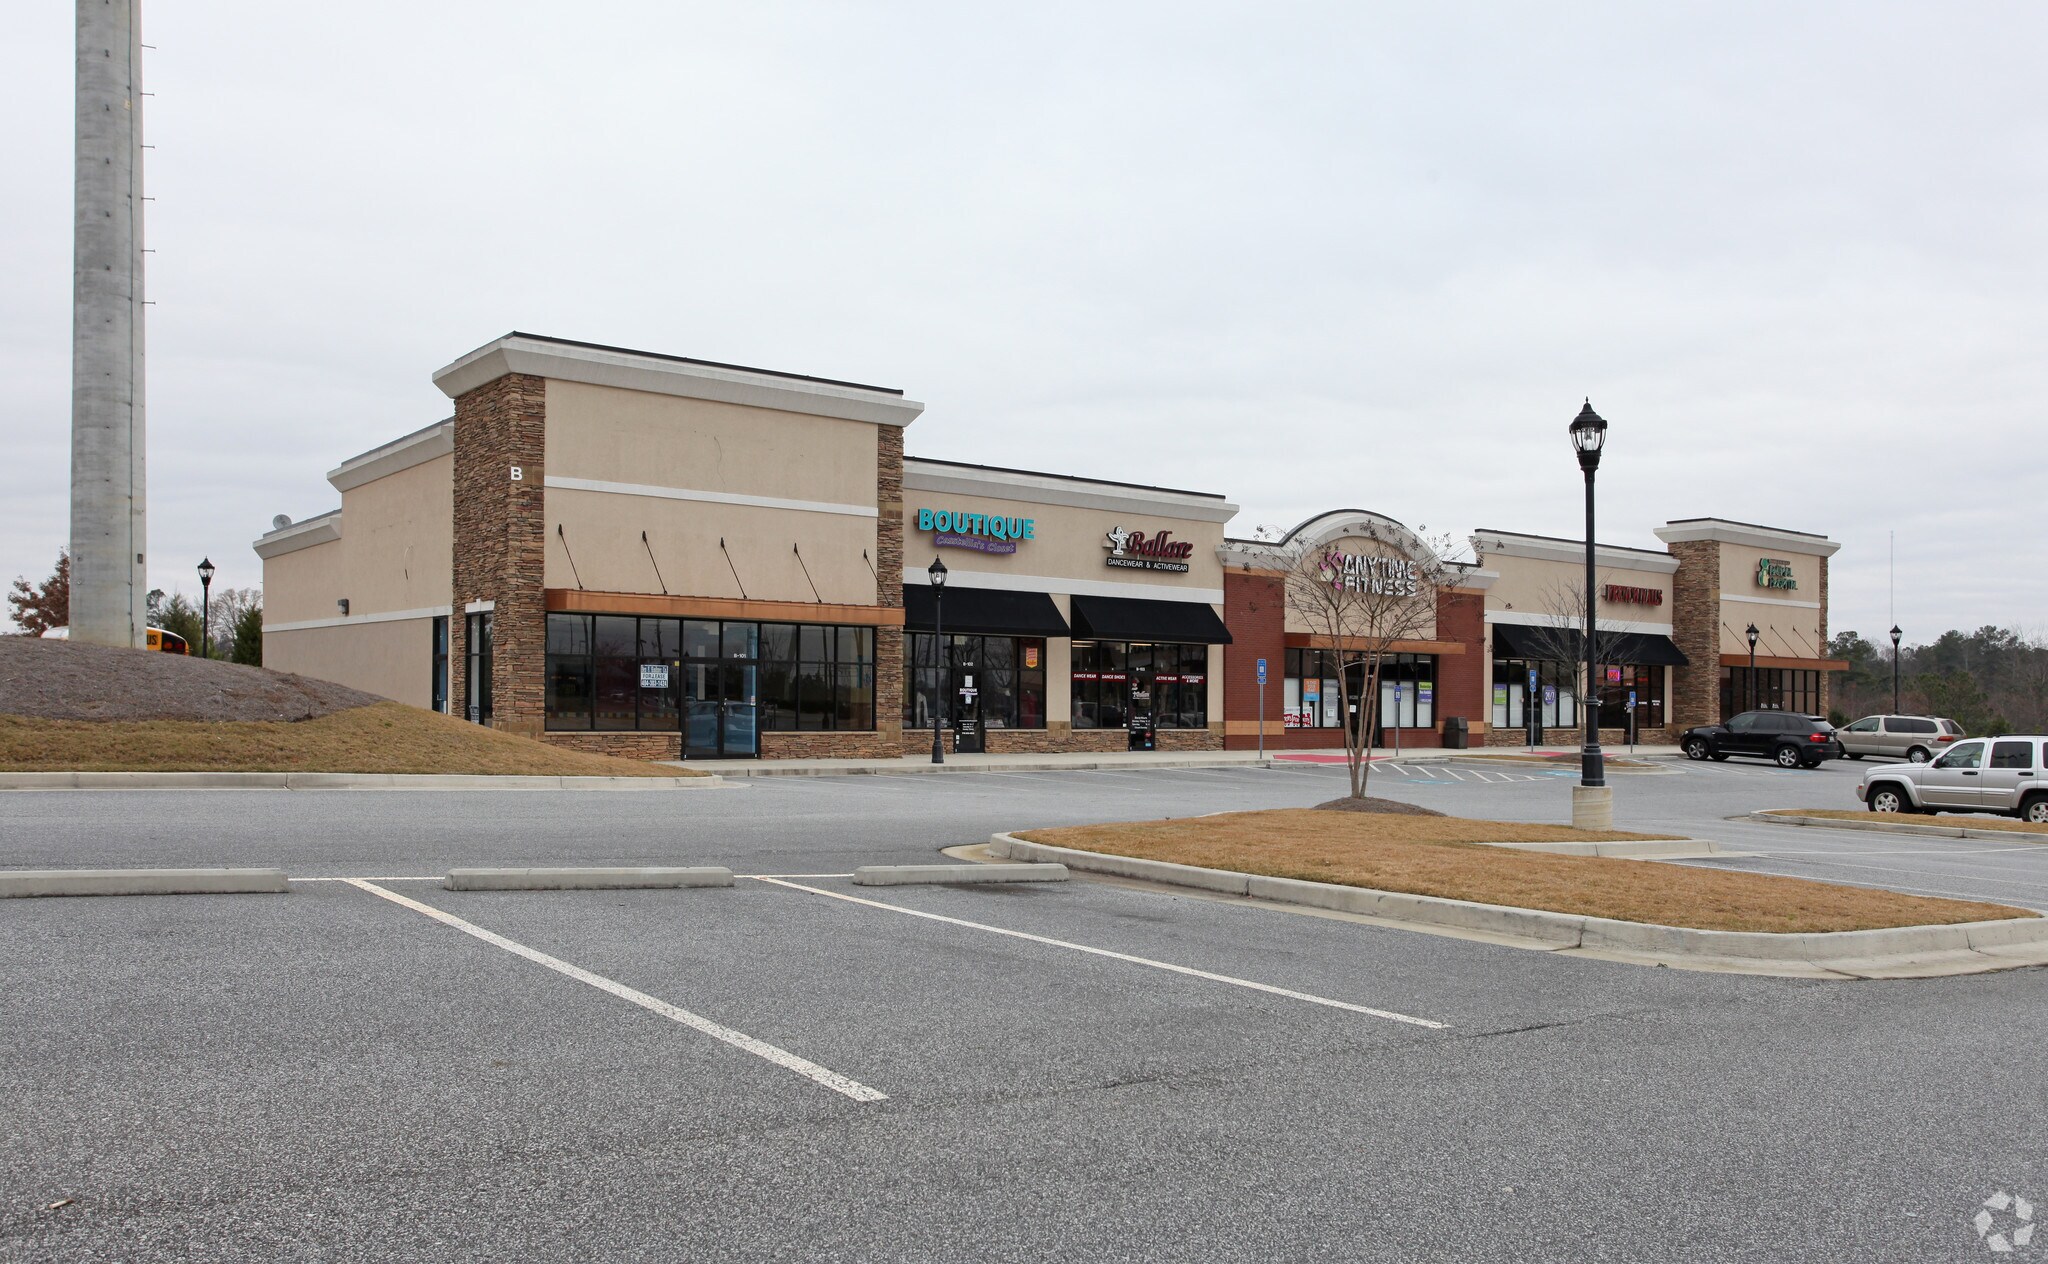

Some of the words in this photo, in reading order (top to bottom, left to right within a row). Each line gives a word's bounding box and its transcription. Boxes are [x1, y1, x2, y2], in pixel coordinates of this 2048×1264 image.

[511, 466, 523, 480] B
[918, 508, 1035, 541] BOUTIQUE
[1126, 530, 1193, 559] Ballare
[1107, 558, 1144, 568] DANCEWEAR
[1145, 561, 1151, 569] &
[1153, 562, 1188, 572] ACTIVEWEAR
[1343, 554, 1417, 580] ANYTIME
[1344, 575, 1417, 597] FITNESS
[147, 634, 157, 646] US
